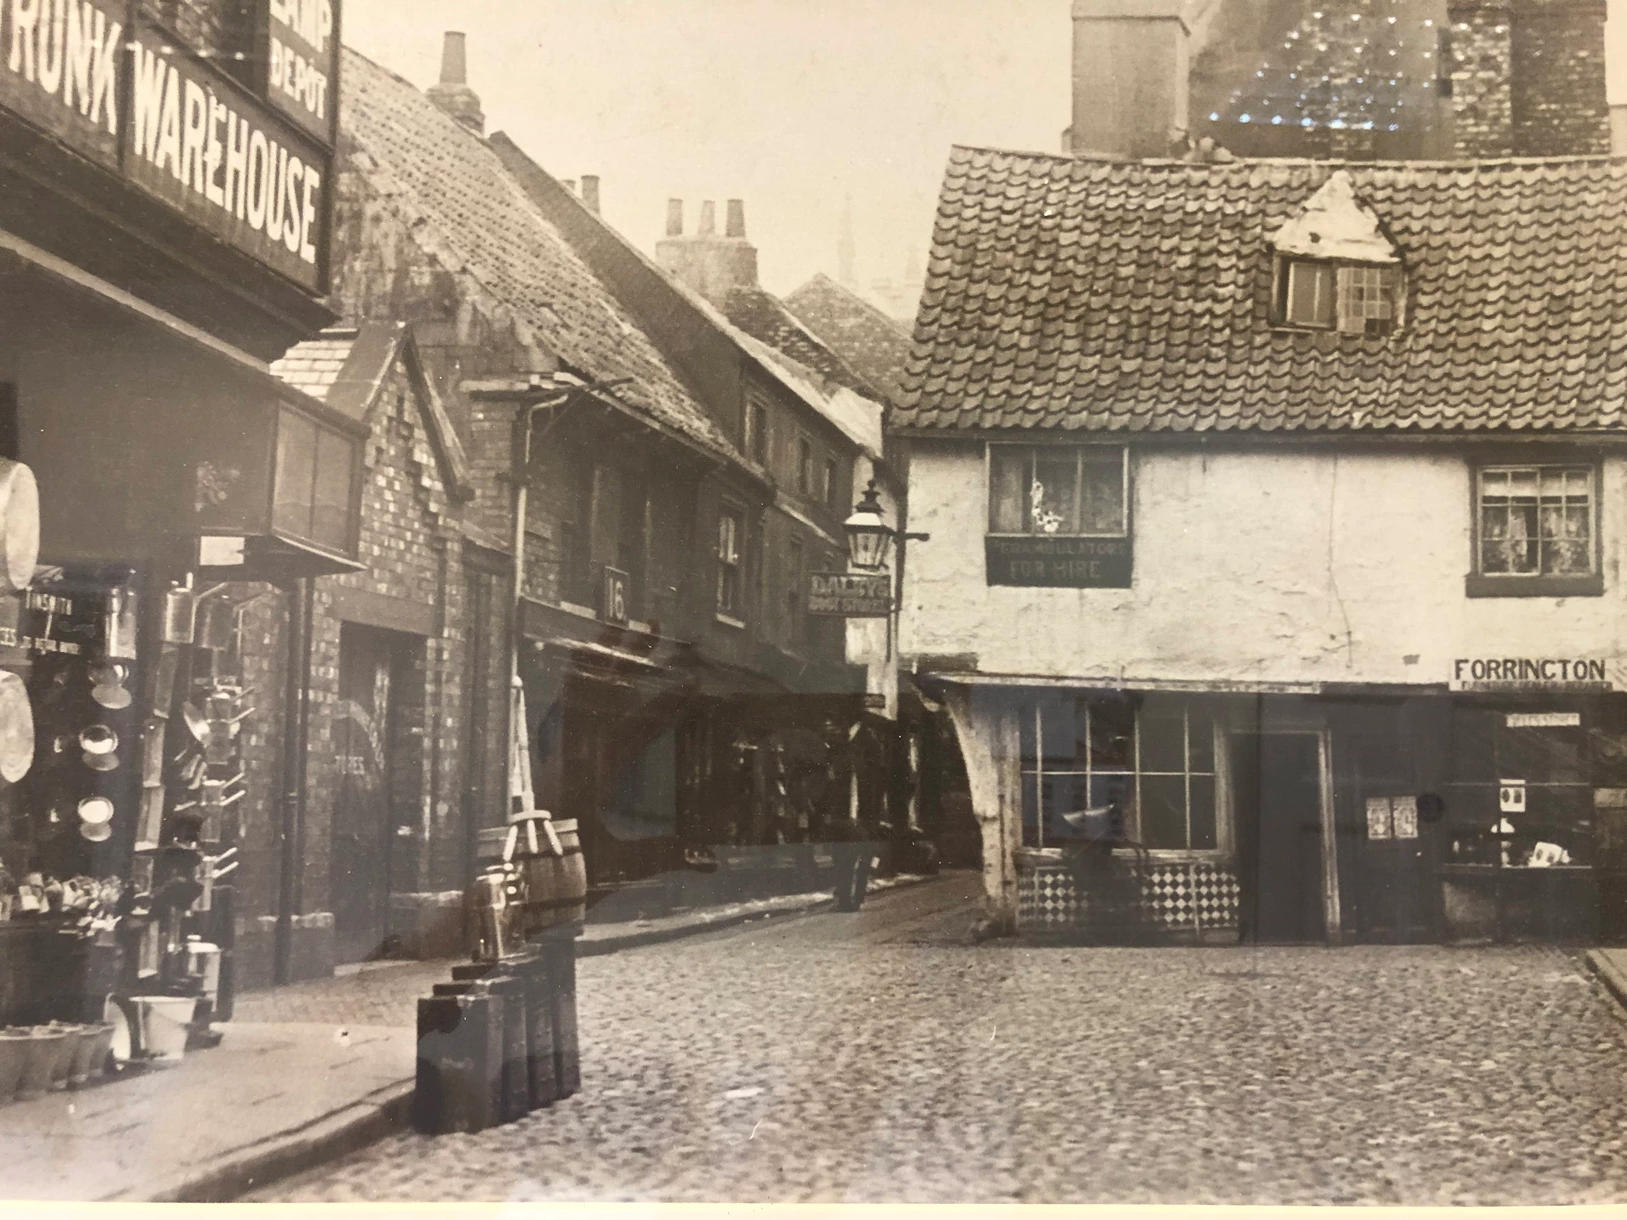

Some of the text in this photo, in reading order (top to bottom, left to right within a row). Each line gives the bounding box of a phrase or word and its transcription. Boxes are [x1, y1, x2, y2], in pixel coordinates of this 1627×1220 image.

[269, 37, 328, 119] DEPOT
[0, 0, 320, 264] RUNK WAREHOUSE
[1009, 560, 1102, 579] FOR HIRE
